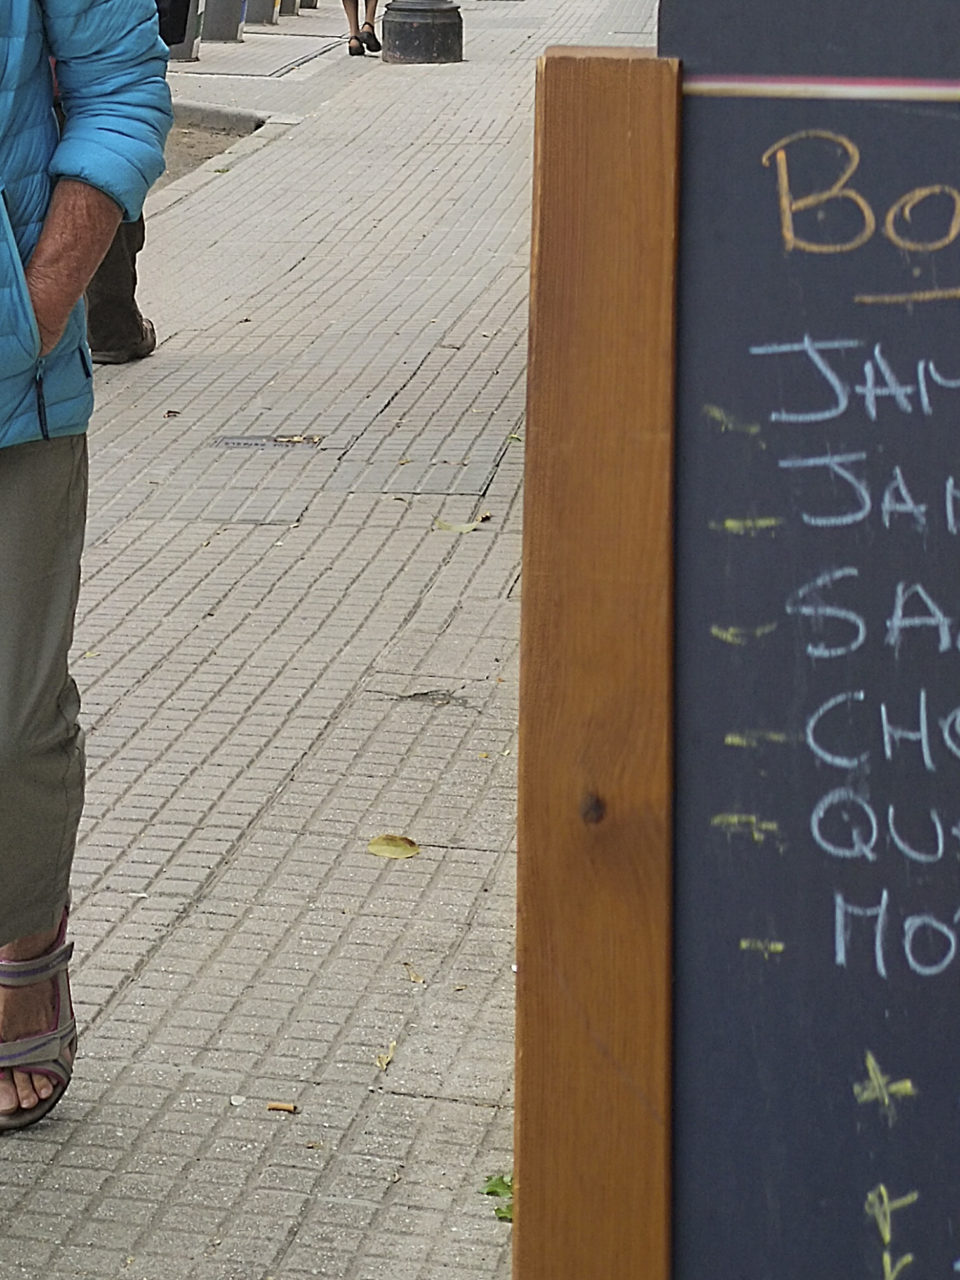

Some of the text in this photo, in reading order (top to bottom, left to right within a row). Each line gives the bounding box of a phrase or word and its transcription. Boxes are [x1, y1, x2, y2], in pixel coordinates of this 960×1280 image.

[785, 566, 960, 657] SA
[811, 787, 960, 863] QU
[835, 888, 960, 980] MO
